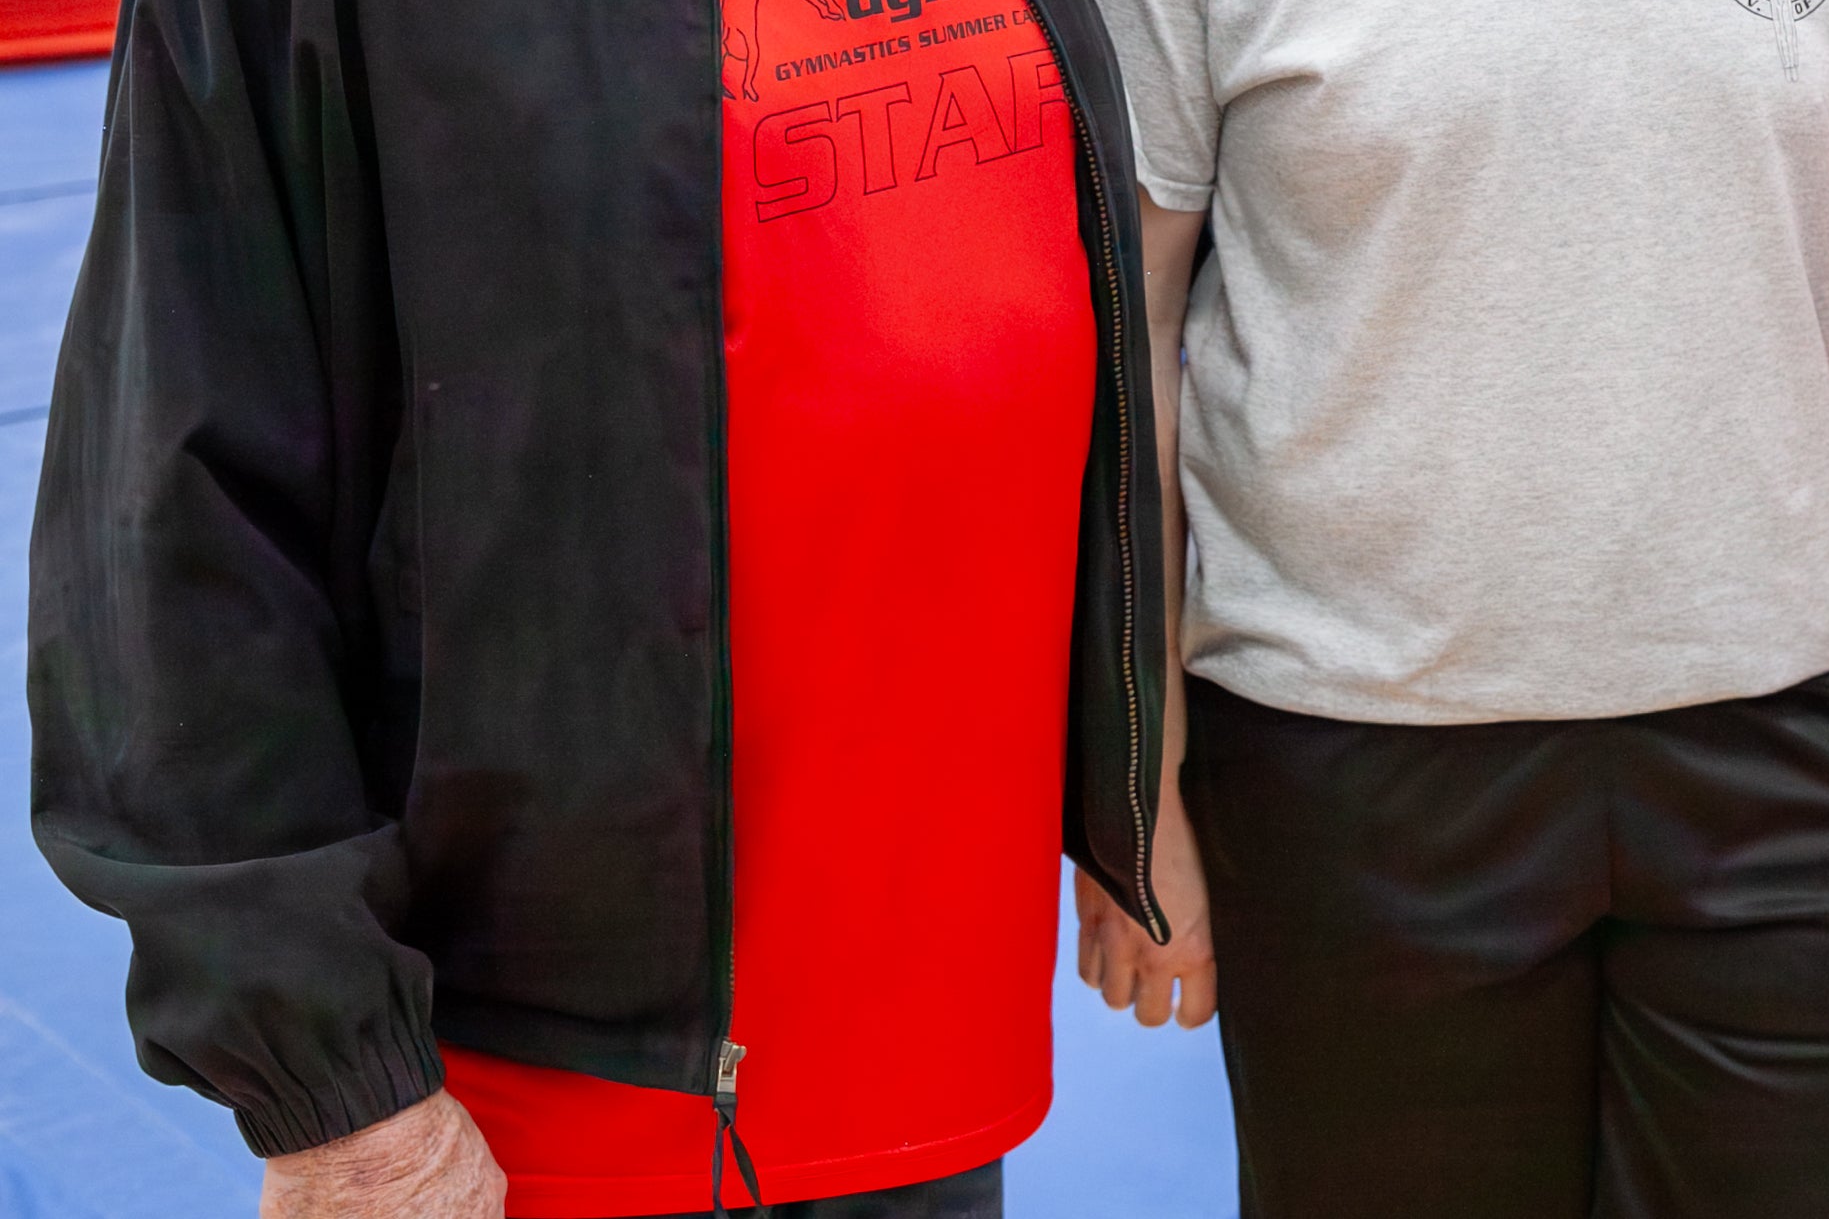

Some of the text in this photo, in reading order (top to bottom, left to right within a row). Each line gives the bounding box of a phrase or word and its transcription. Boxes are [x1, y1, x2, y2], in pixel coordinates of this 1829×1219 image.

[775, 9, 1037, 81] GYMNASTICS SUMMER CA
[753, 48, 1070, 224] STAF
